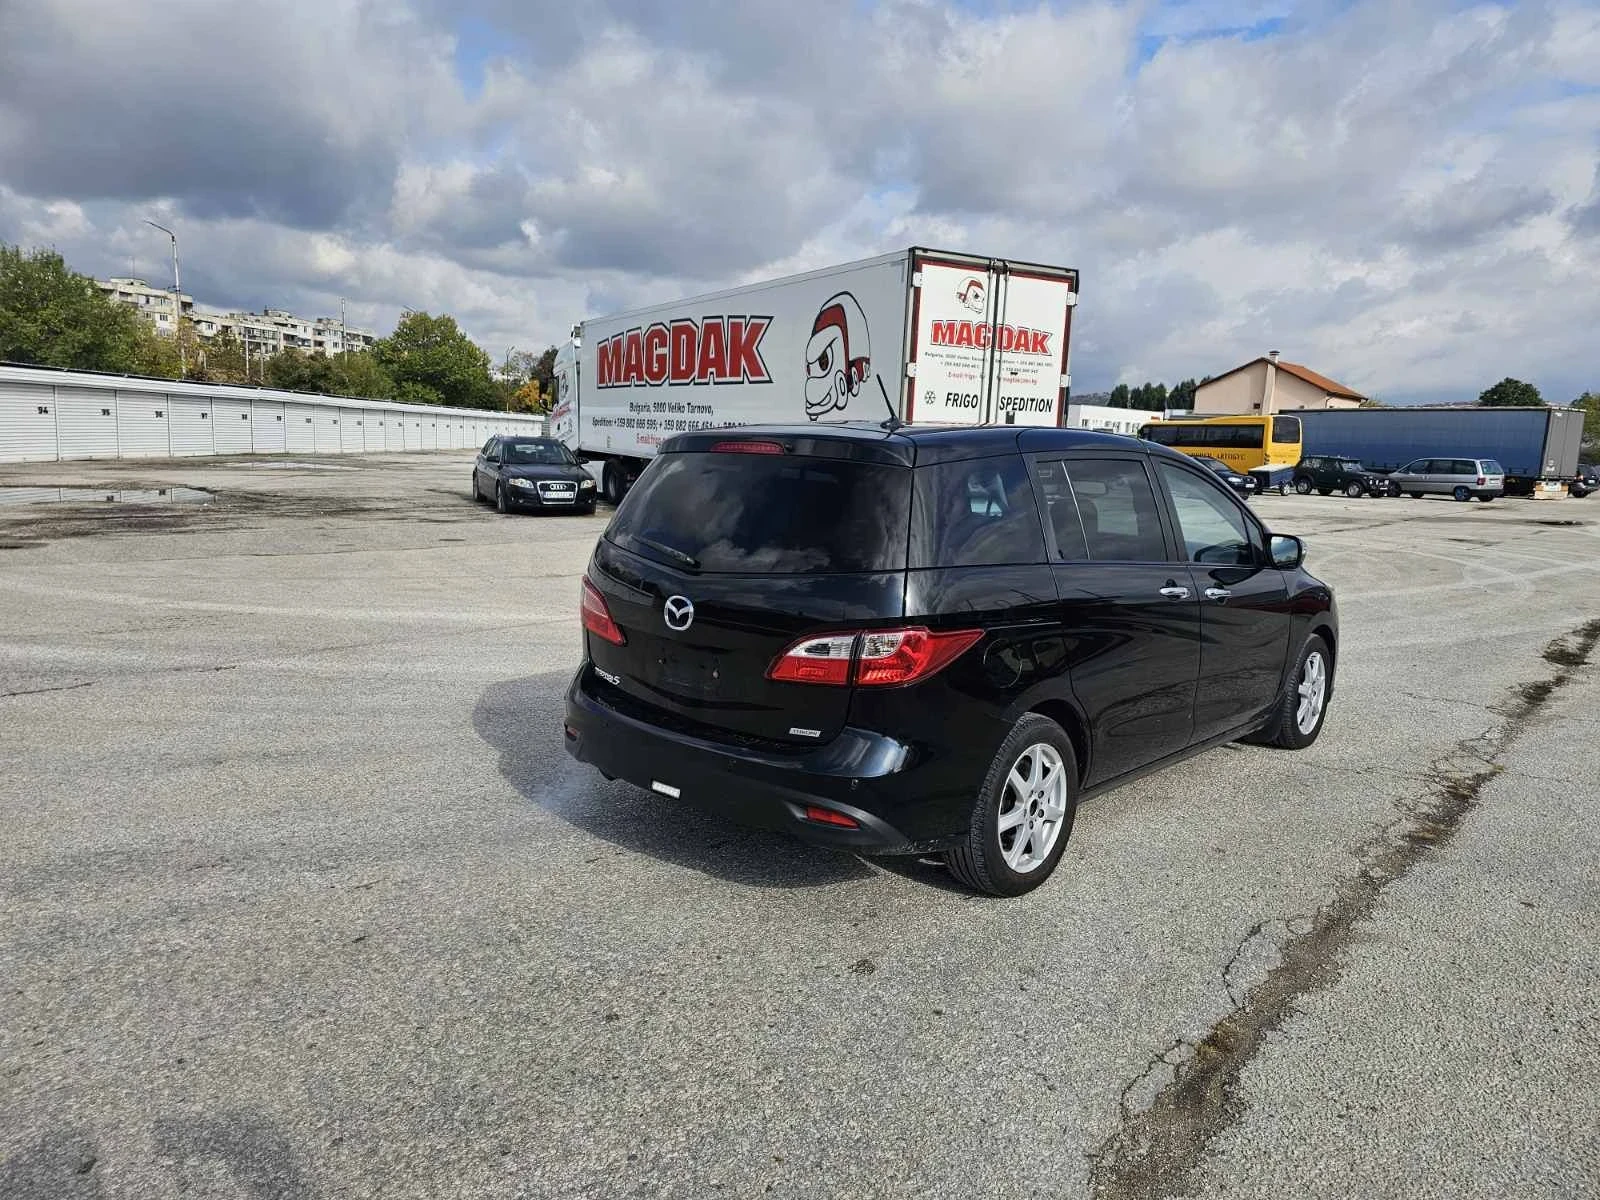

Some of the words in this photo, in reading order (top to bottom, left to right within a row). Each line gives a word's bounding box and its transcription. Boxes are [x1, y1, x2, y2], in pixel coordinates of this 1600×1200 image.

[931, 319, 1053, 356] MAGDAK
[597, 315, 774, 388] MAGDAK
[38, 407, 49, 415] 94
[668, 402, 685, 414] Veliko
[687, 403, 714, 416] Tarnovo,
[945, 392, 979, 409] FRIGO
[1000, 395, 1053, 413] SPEDITION
[664, 420, 675, 431] 359
